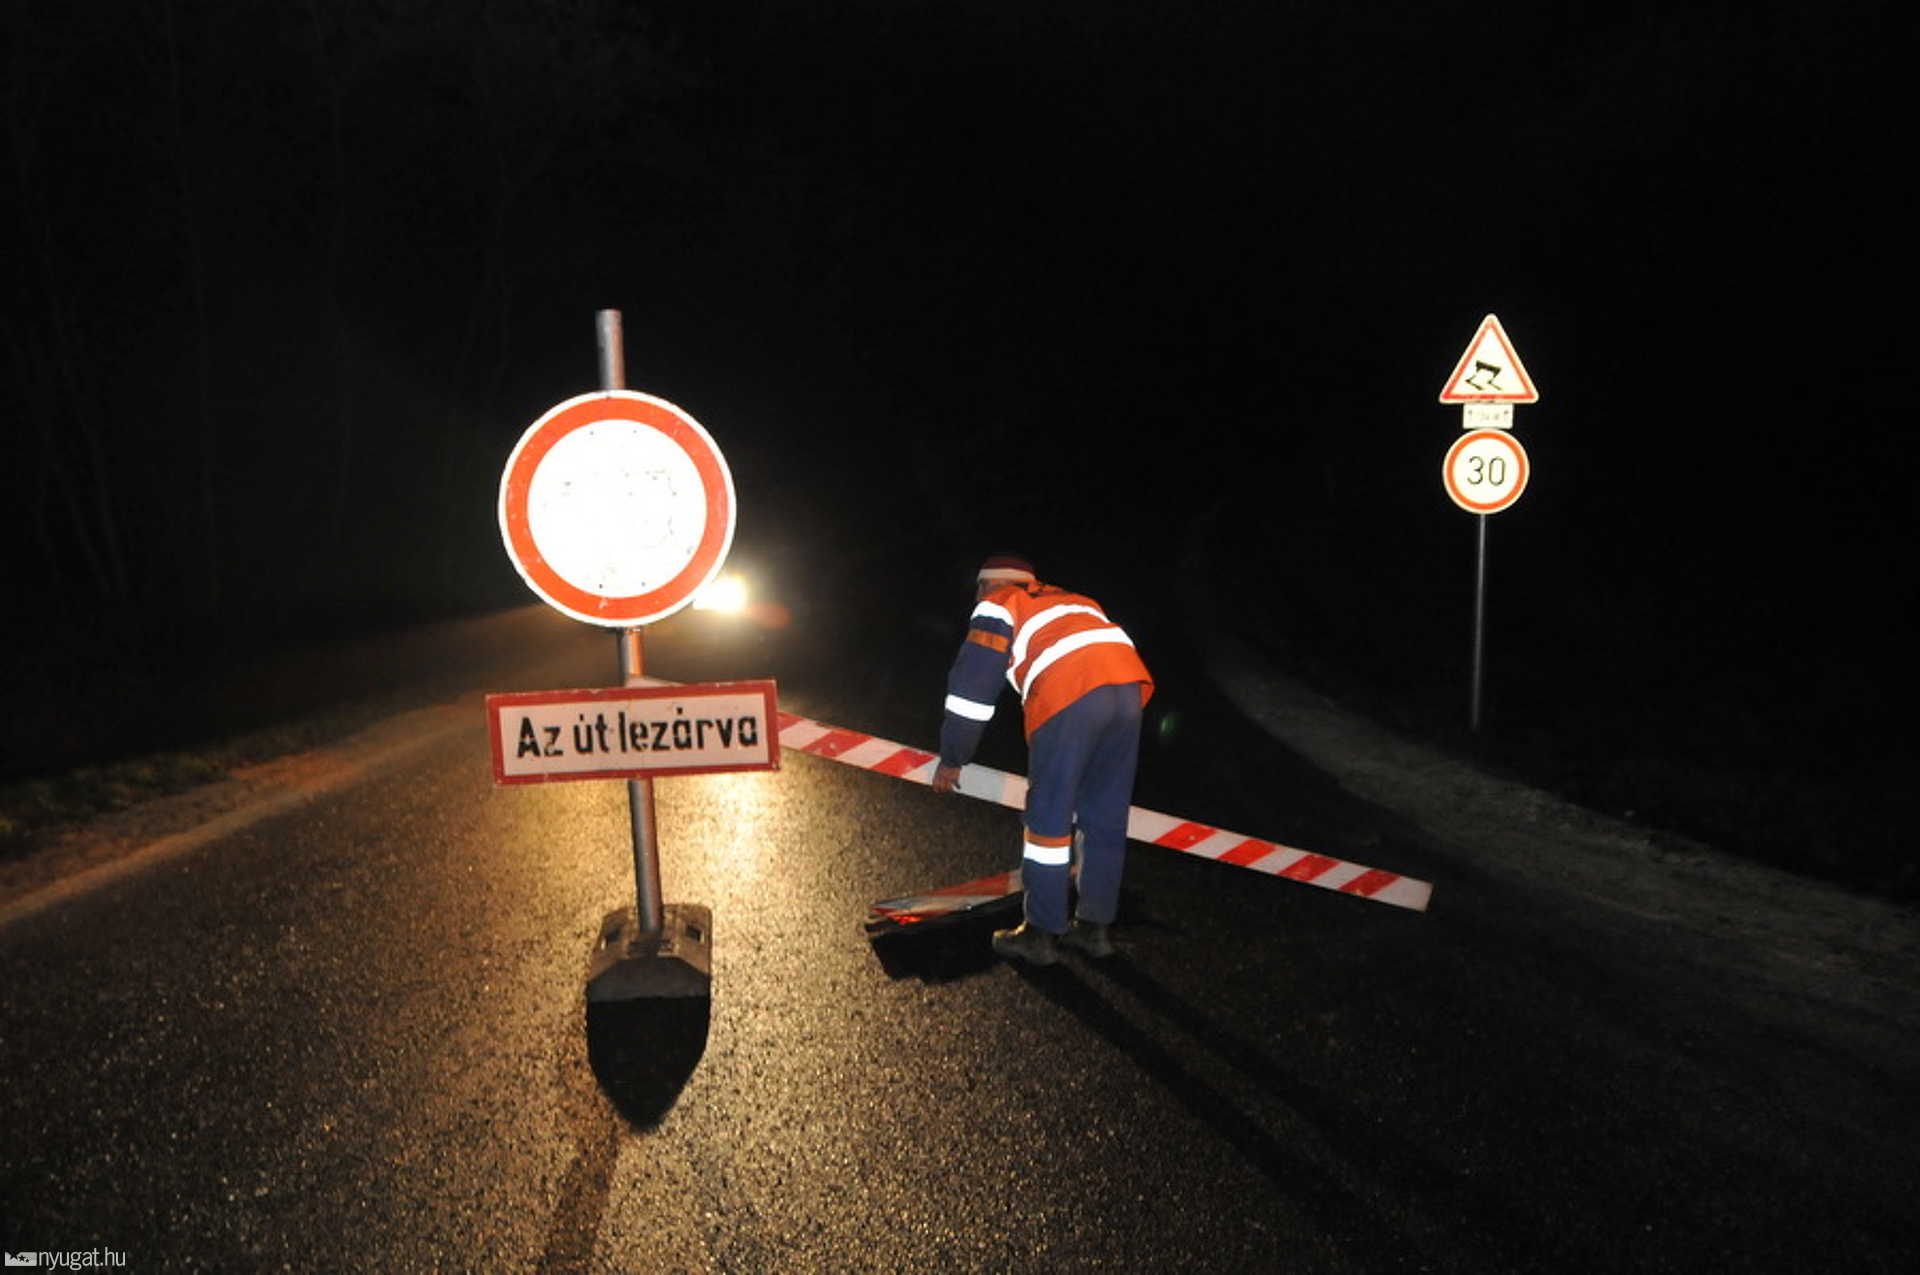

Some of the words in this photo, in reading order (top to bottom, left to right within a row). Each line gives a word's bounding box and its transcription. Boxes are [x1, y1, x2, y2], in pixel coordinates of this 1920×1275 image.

[1466, 456, 1505, 486] 30
[517, 716, 563, 758] Az
[573, 713, 610, 754] út
[619, 707, 758, 753] lezárva
